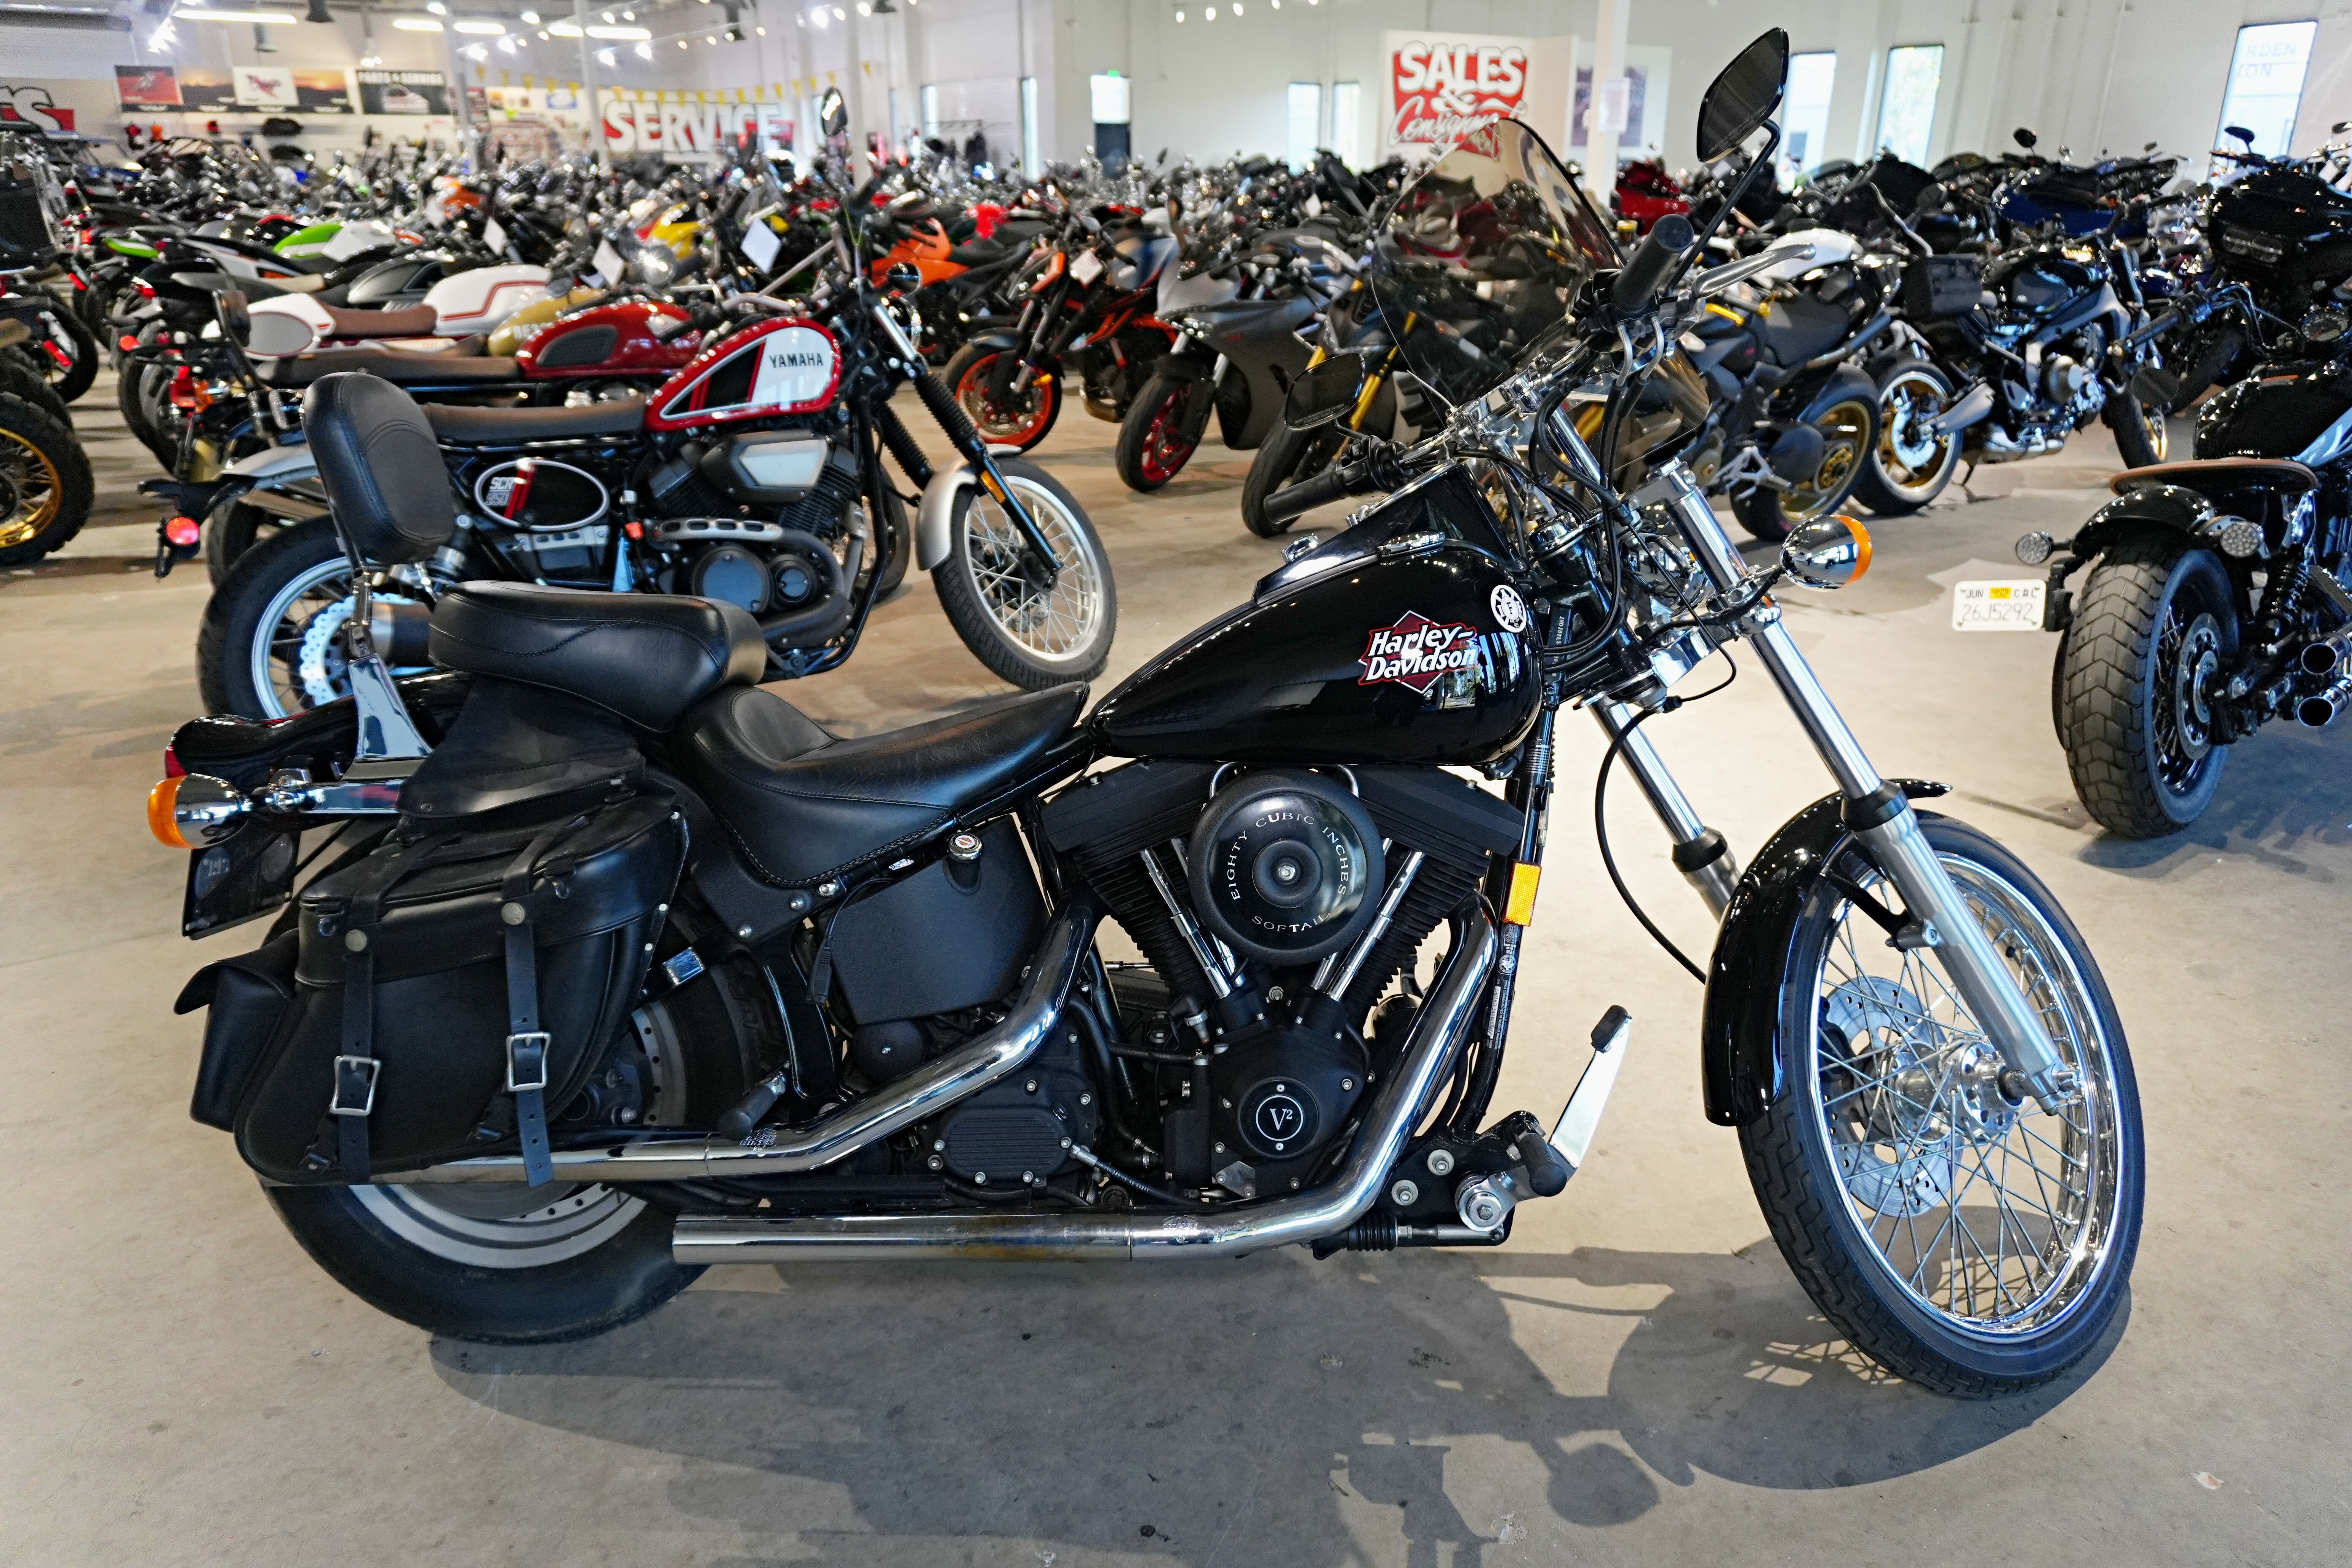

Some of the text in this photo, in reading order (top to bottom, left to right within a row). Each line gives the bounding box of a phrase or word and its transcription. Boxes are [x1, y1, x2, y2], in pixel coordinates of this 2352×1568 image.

[1398, 41, 1524, 96] SALES
[607, 100, 782, 153] SERVICE
[769, 353, 823, 368] YAMAHA
[490, 477, 514, 489] SCR
[485, 492, 509, 505] 950
[1967, 589, 1984, 598] JUN
[1963, 602, 2033, 620] 26J5292
[1368, 624, 1473, 656] Harley-
[1365, 647, 1476, 681] Davidson
[1227, 812, 1349, 901] EIGHTY CUBIC INCHES
[1252, 912, 1329, 933] SOFTAIL
